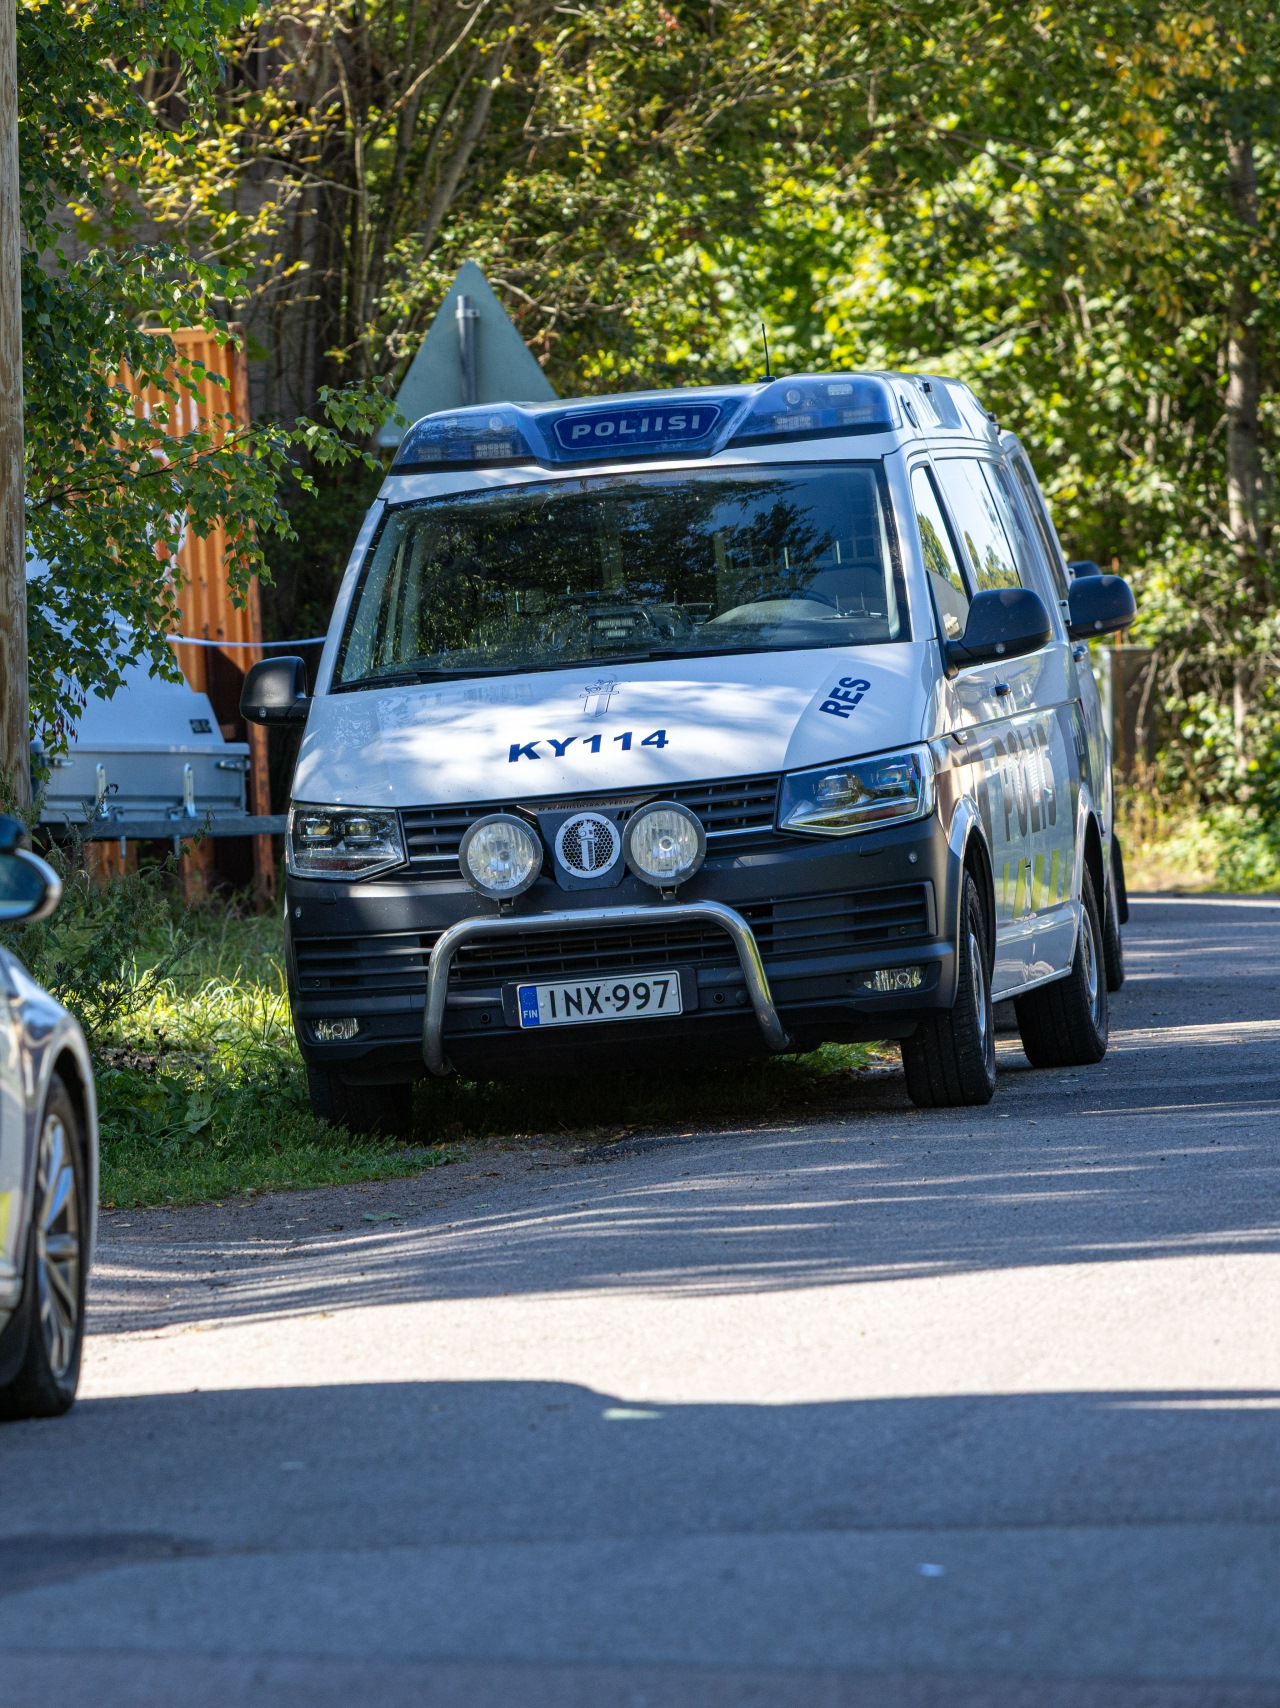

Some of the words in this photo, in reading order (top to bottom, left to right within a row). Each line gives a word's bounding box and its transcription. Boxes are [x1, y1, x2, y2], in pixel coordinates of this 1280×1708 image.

[571, 414, 700, 440] POLIISI
[818, 676, 871, 719] RES
[508, 729, 669, 763] KY114
[991, 722, 1057, 842] POLIS
[523, 1009, 538, 1019] FIN
[549, 979, 670, 1018] INX-997
